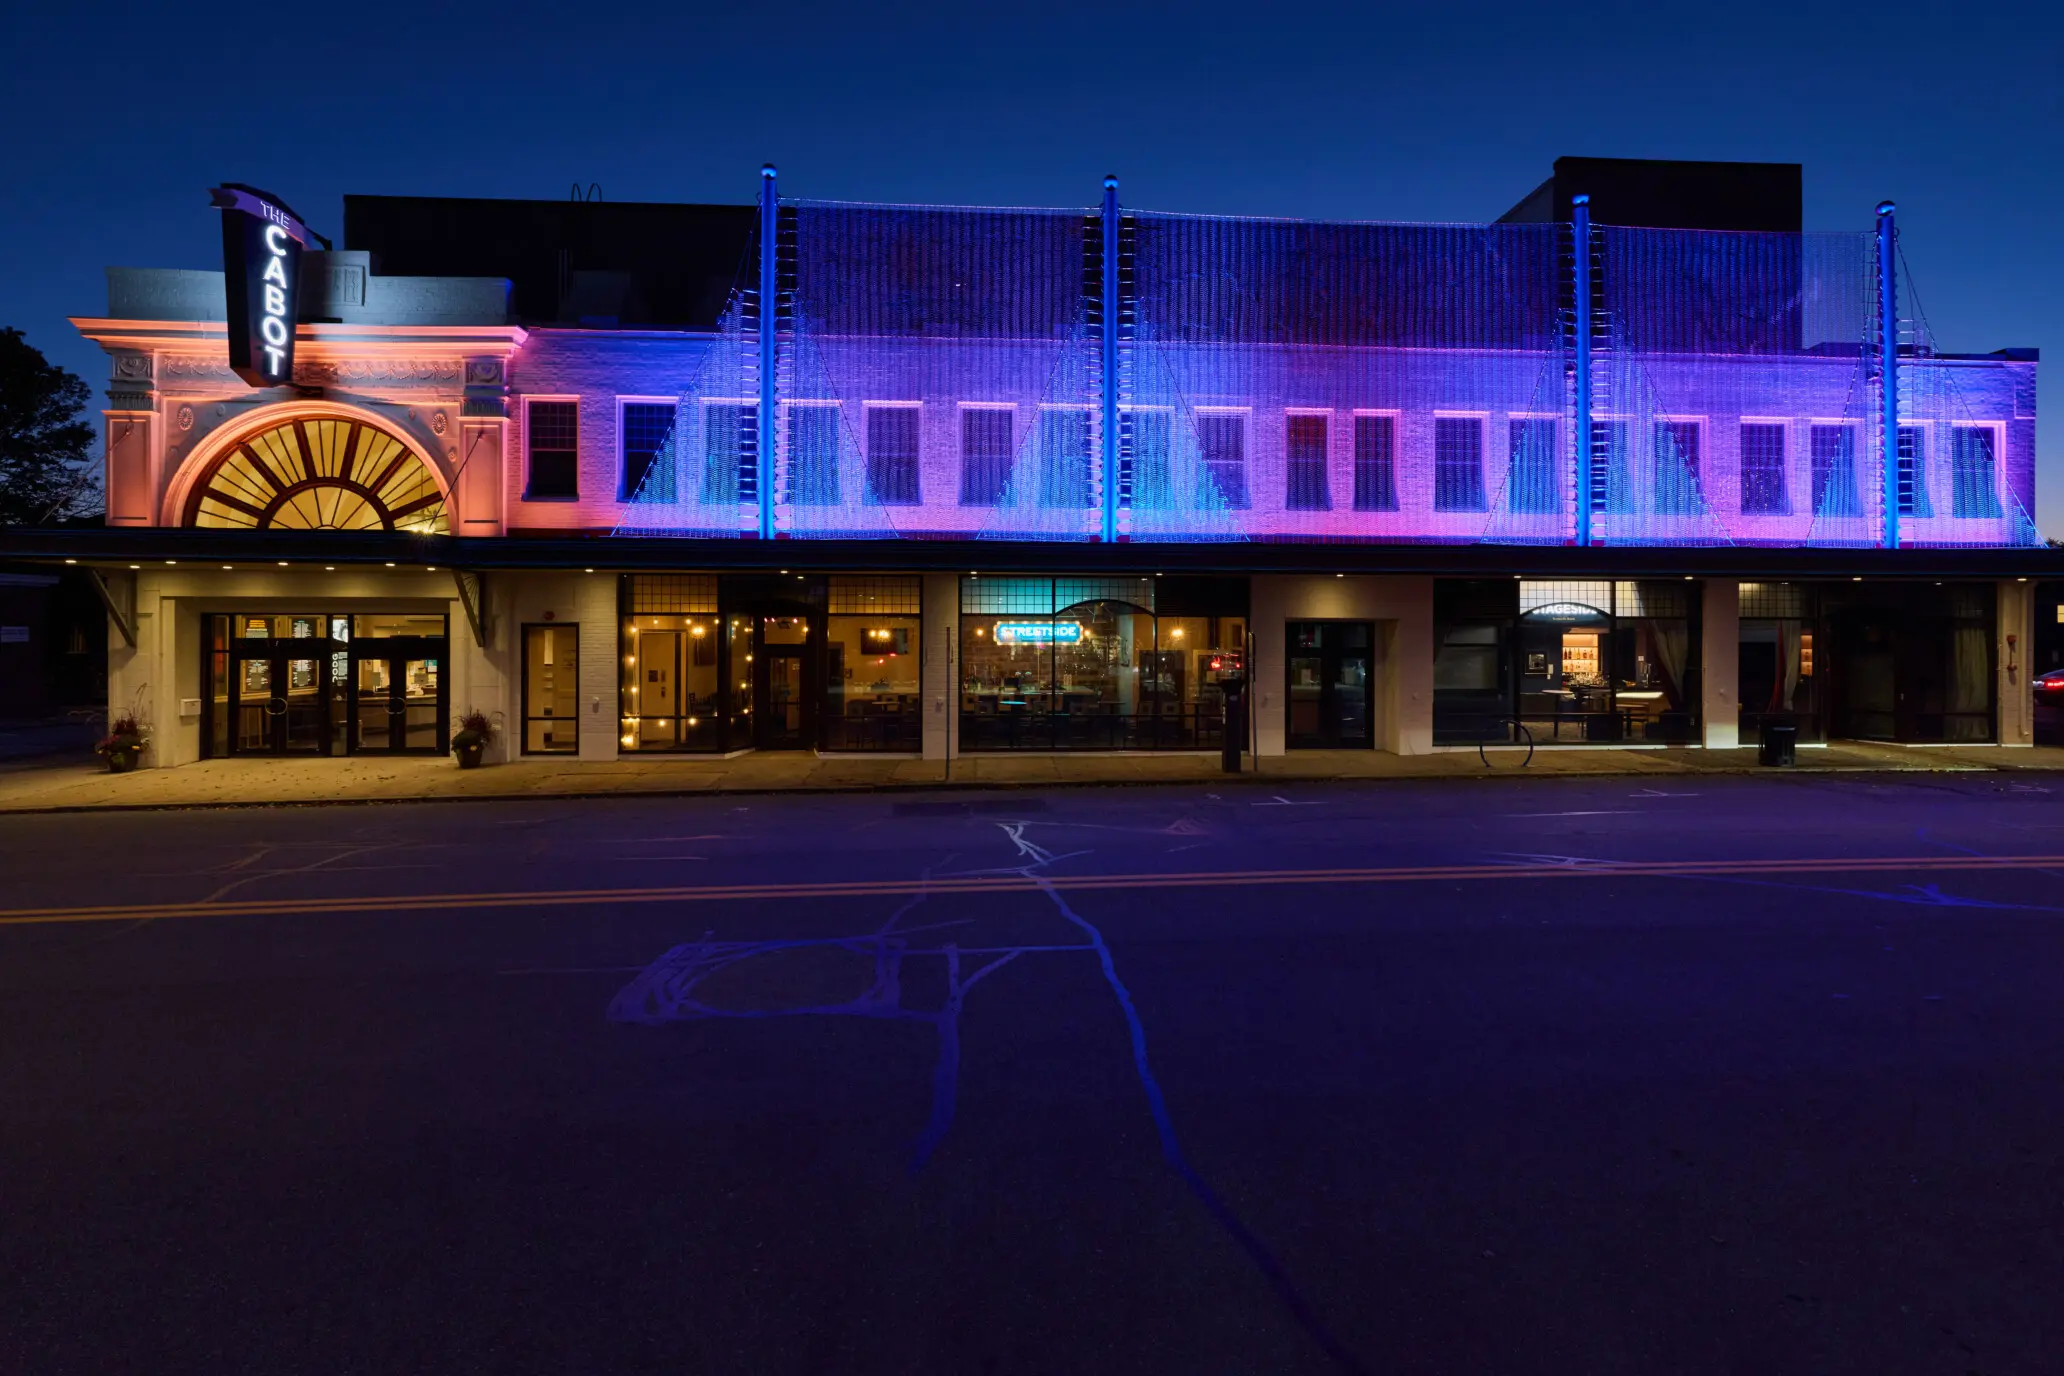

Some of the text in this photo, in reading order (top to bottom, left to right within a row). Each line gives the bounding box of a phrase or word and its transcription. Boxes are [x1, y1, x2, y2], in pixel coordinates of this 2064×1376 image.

[260, 200, 291, 230] THE
[262, 224, 288, 376] CABOT
[1000, 626, 1077, 637] STREETSIDE
